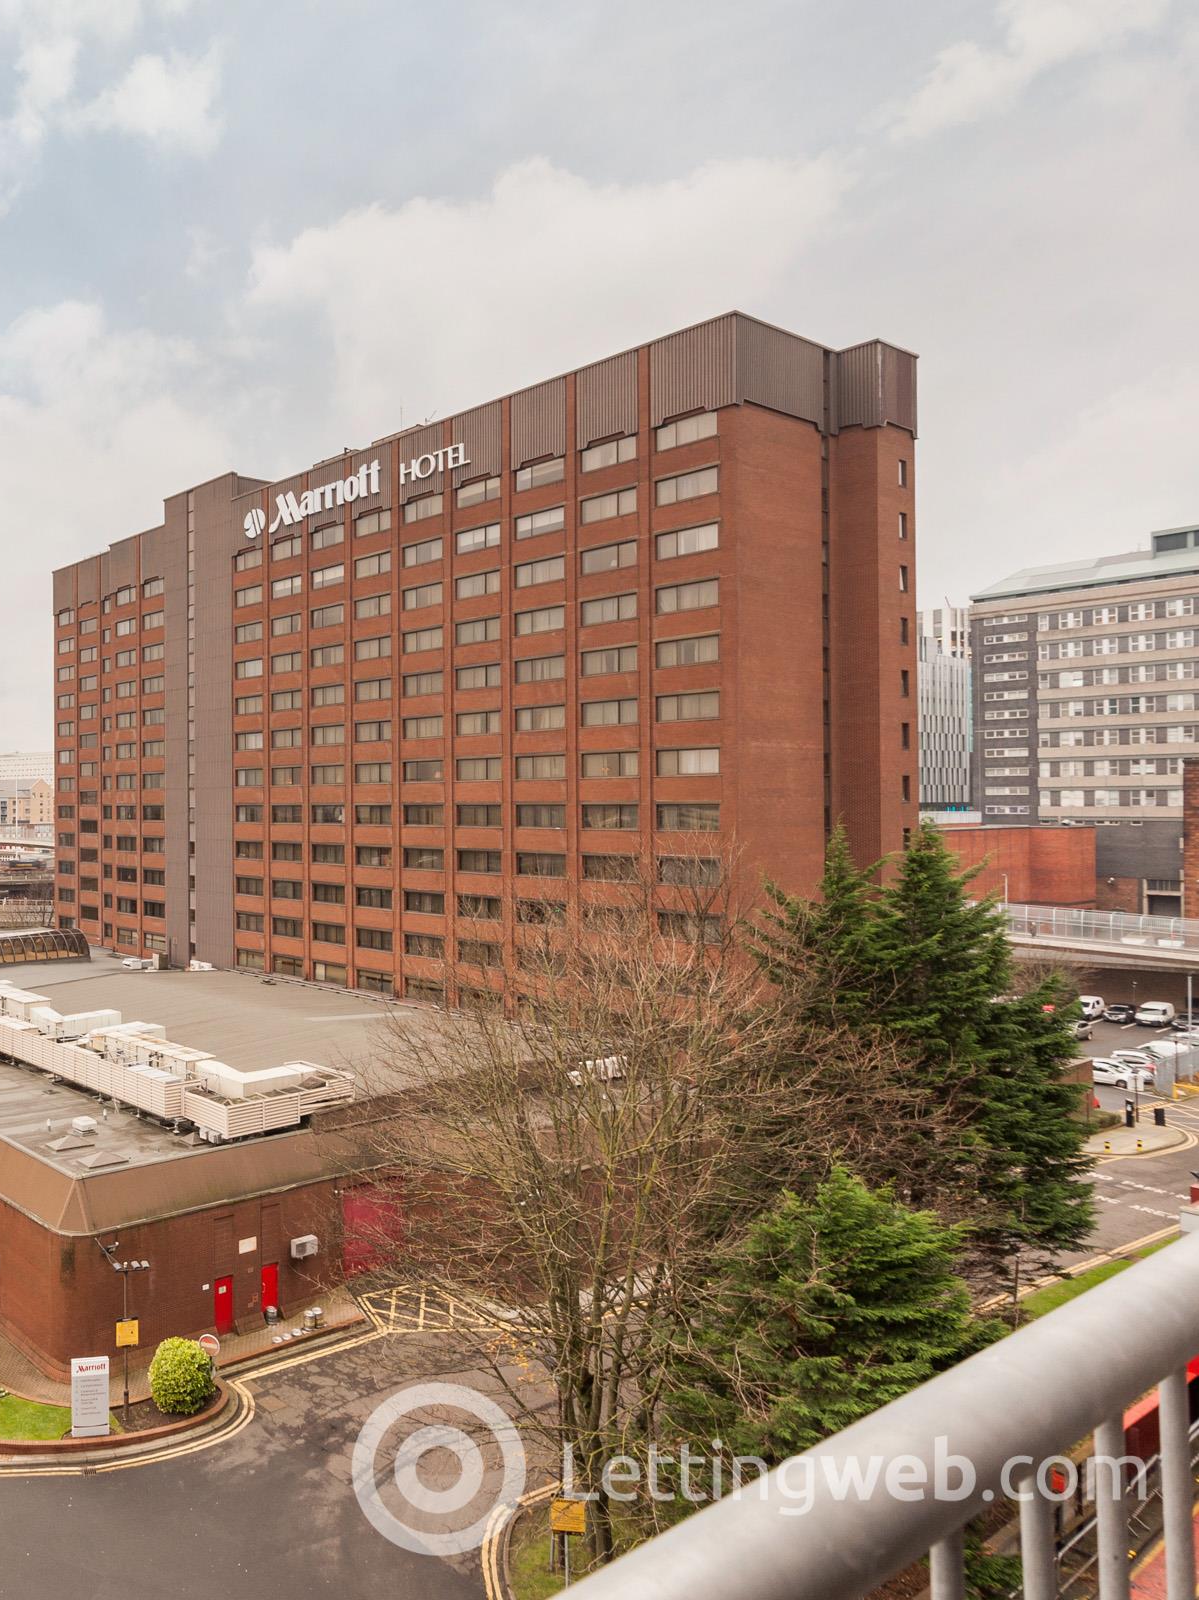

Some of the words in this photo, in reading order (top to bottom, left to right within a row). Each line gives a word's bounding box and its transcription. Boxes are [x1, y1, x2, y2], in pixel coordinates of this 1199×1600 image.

[268, 459, 381, 534] Marriott
[399, 442, 471, 485] HOTEL
[76, 1363, 106, 1373] Marriott
